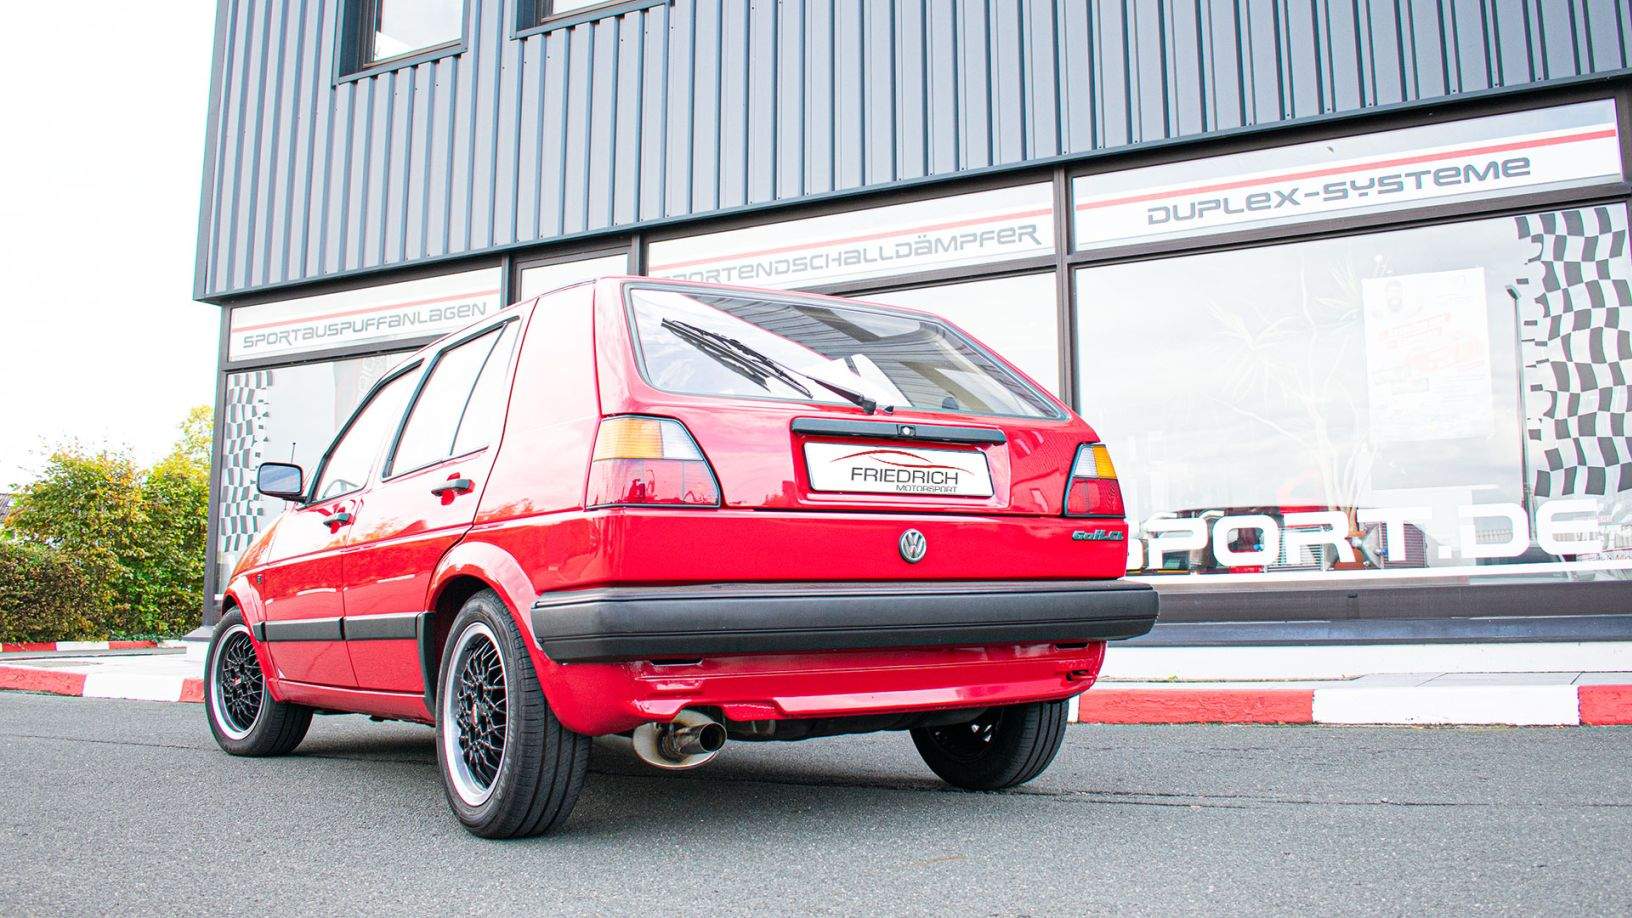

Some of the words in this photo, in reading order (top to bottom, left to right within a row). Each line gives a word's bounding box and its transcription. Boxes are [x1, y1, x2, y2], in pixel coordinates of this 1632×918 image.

[1148, 157, 1530, 224] DUPLEX-SYSTEME
[664, 224, 1041, 284] ORTENDSCHALLDÄMPFER
[243, 303, 487, 348] SPORTAUSPUFFANLAGEN
[851, 467, 958, 484] FRIEDRICH
[896, 485, 957, 493] MOTORSPORT
[899, 529, 926, 562] VW
[1126, 499, 1602, 571] PORT.DE
